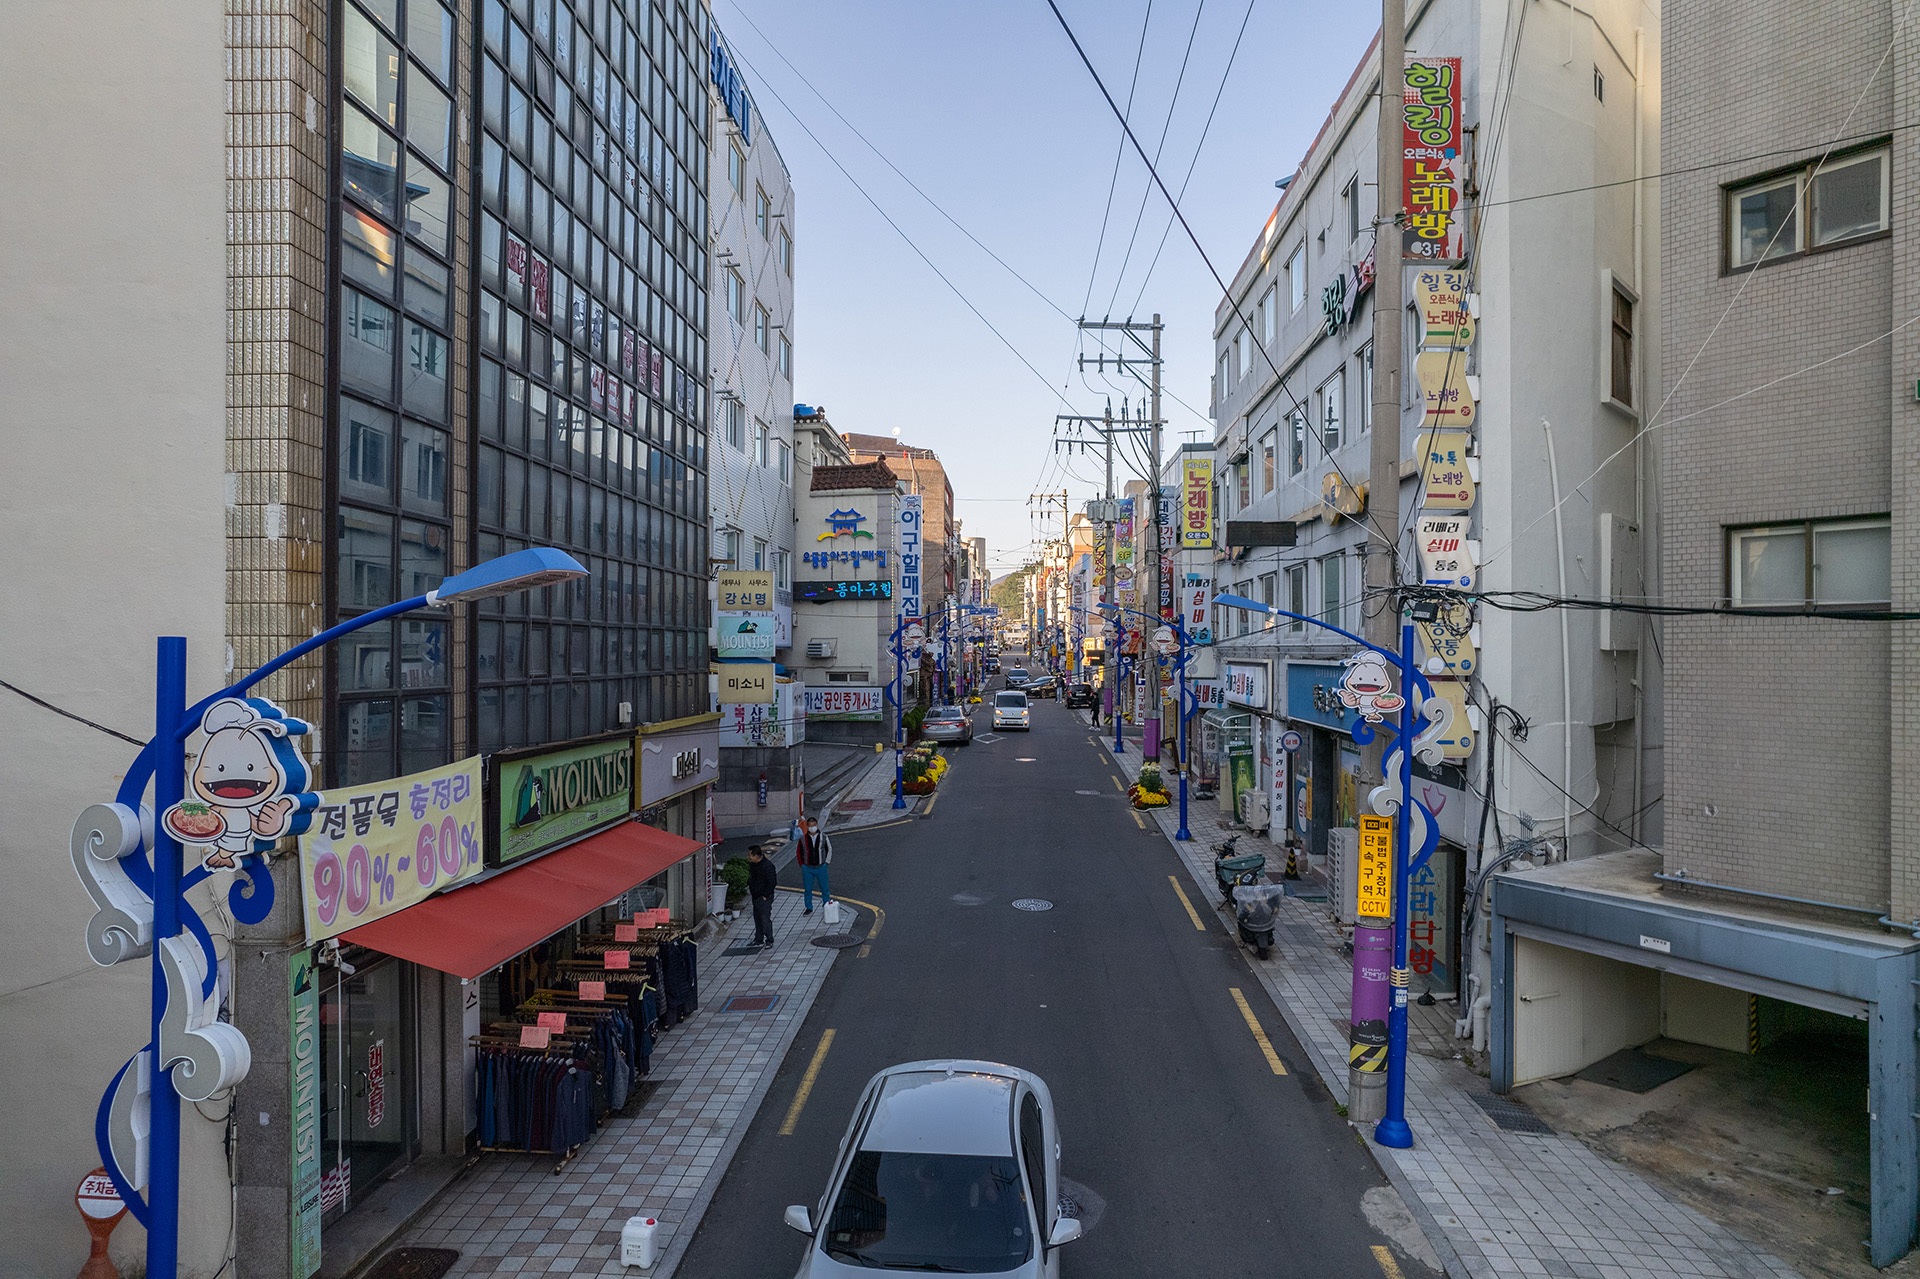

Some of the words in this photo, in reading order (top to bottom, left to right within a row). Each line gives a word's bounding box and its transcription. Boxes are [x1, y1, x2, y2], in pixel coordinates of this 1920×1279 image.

[1400, 63, 1452, 145] 힐링
[1409, 162, 1455, 239] 노래방
[1421, 273, 1462, 292] 힐링
[1427, 310, 1469, 325] 노래방
[1427, 389, 1459, 402] 노래방
[1461, 406, 1470, 415] 2F
[1431, 472, 1464, 485] 노래방
[1188, 471, 1209, 530] 노래방
[1458, 491, 1468, 500] 2F
[1422, 521, 1461, 534] 리베라
[1426, 538, 1460, 553] 실비
[1118, 551, 1132, 561] 3F
[901, 511, 920, 617] 아구할매집
[725, 592, 767, 606] 강신명
[1192, 591, 1205, 624] 실비
[720, 634, 772, 649] MOUNTIST
[1430, 638, 1460, 657] 유통
[1461, 660, 1471, 669] 1F
[728, 678, 765, 690] 미소니
[672, 748, 701, 779] 미소니
[542, 749, 634, 815] MOUNTIST
[319, 791, 400, 841] 전품목
[409, 774, 471, 821] 총정리
[1376, 835, 1387, 857] 불법
[1361, 900, 1387, 913] CCTV
[1409, 863, 1437, 974] 소라다방
[294, 1005, 315, 1167] MOUNTIST
[85, 1180, 118, 1195] 주차금
